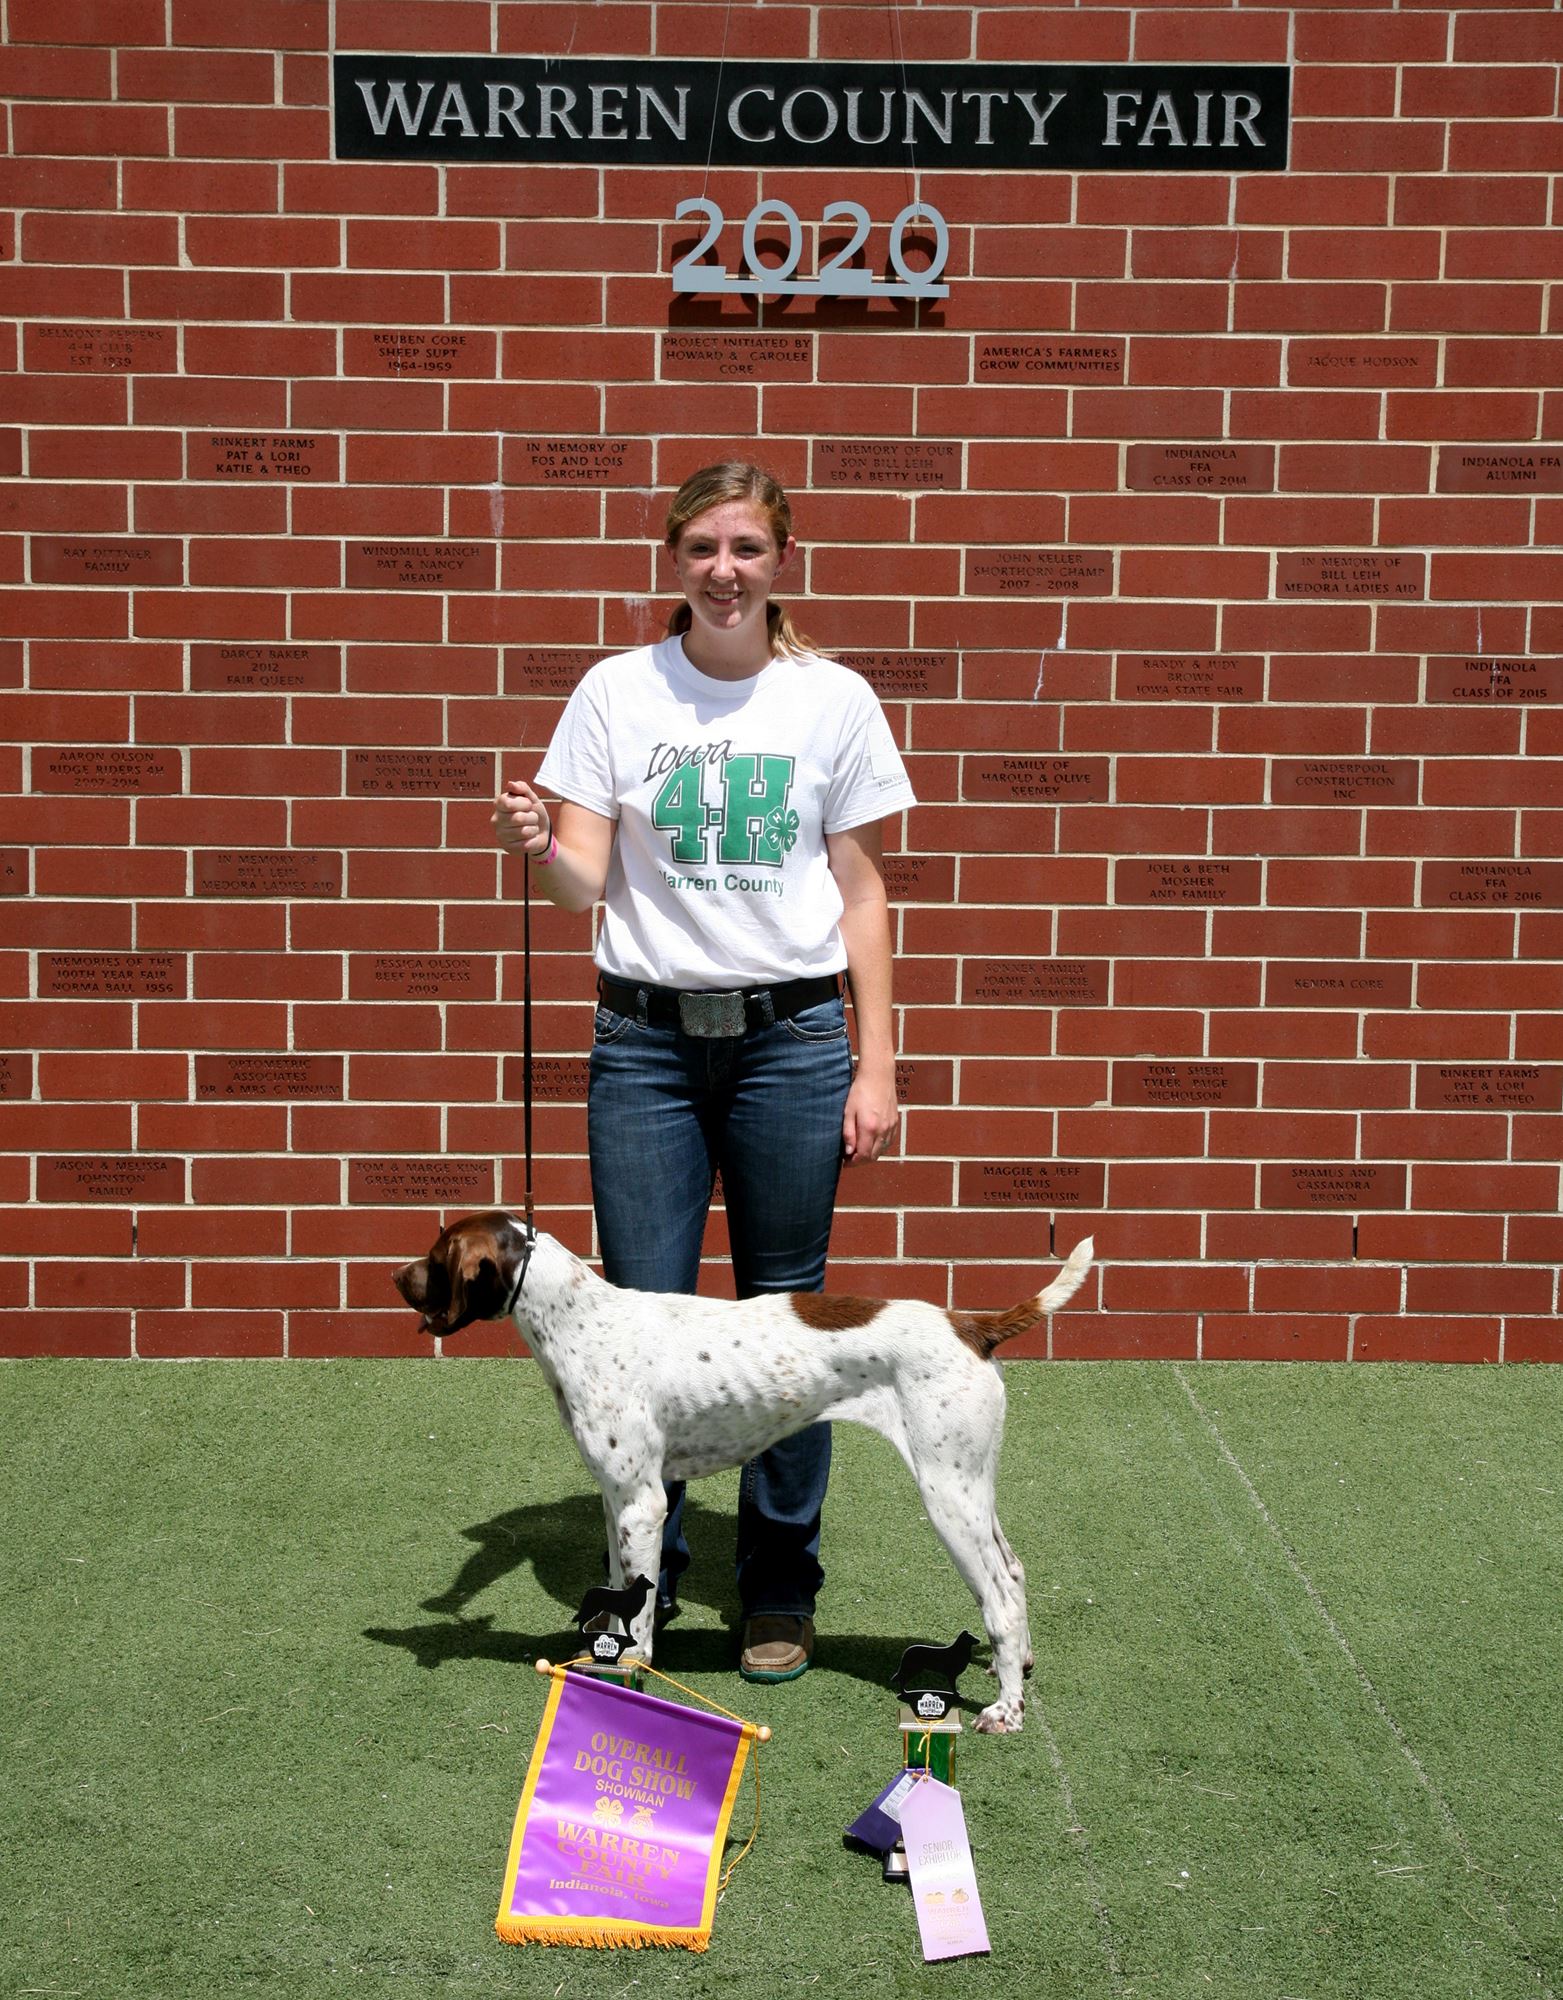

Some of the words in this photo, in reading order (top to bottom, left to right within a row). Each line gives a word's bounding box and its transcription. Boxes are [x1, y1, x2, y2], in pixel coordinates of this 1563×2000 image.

[353, 79, 690, 140] WARREN
[727, 88, 1068, 146] COUNTY
[1102, 93, 1267, 148] FAIR
[673, 197, 949, 288] 2020
[373, 336, 426, 345] REUBEN
[431, 336, 466, 345] CORE
[664, 338, 718, 348] PROJECT
[724, 338, 788, 348] INITIATED
[794, 338, 810, 348] BY
[378, 348, 420, 358] SHEEP
[426, 348, 458, 358] SUPT
[666, 351, 724, 362] HOWARD
[728, 351, 738, 362] &
[749, 351, 809, 362] CAROLEE
[982, 348, 1052, 358] AMERICA'S
[1059, 348, 1117, 358] FARMERS
[388, 362, 452, 371] 1964-1969
[720, 365, 754, 374] CORE
[979, 361, 1021, 371] GROW
[1025, 361, 1120, 371] COMMUNITIES
[211, 438, 267, 449] RINKERT
[273, 438, 315, 449] FARMS
[527, 443, 540, 454] IN
[547, 443, 605, 454] MEMORY
[611, 443, 628, 454] OF
[821, 445, 834, 456] IN
[841, 445, 899, 456] MEMORY
[905, 445, 921, 456] OF
[928, 445, 953, 456] OUR
[1165, 450, 1237, 459] INDIANOLA
[226, 451, 248, 461] PAT
[255, 451, 264, 461] &
[271, 451, 300, 461] LORI
[531, 456, 556, 466] FOS
[561, 456, 588, 466] AND
[594, 456, 623, 466] LOIS
[1462, 457, 1534, 467] INDIANOLA
[1540, 457, 1561, 467] FFA
[216, 464, 253, 475] KATIE
[260, 464, 268, 475] &
[275, 464, 311, 475] THEO
[1190, 463, 1211, 472] FFA
[544, 469, 609, 479] SARCHETT
[830, 472, 847, 482] ED
[854, 472, 863, 482] &
[869, 472, 908, 482] BETTY
[915, 472, 943, 482] LEIH
[1486, 470, 1537, 480] ALUMNI
[1153, 476, 1191, 485] CLASS
[1197, 476, 1214, 485] OF
[1219, 476, 1247, 485] 2014
[362, 547, 430, 557] WINDMILL
[435, 547, 480, 557] RANCH
[996, 554, 1032, 564] JOHN
[1038, 554, 1083, 564] KELLER
[1302, 558, 1316, 568] IN
[1321, 558, 1378, 568] MEMORY
[1384, 558, 1401, 568] OF
[377, 560, 398, 570] PAT
[404, 560, 413, 570] &
[420, 560, 464, 570] NANCY
[974, 567, 1053, 577] SHORTHORN
[1060, 567, 1105, 577] CHAMP
[1321, 570, 1346, 580] BILL
[1352, 570, 1381, 580] LEIH
[398, 573, 444, 583] MEADE
[220, 649, 262, 660] DARCY
[269, 649, 309, 660] BAKER
[251, 663, 279, 673] 2012
[1465, 662, 1536, 673] INDIANOLA
[227, 676, 254, 686] FAIR
[260, 676, 304, 686] QUEEN
[1489, 675, 1511, 686] FFA
[1452, 688, 1490, 698] CLASS
[1495, 688, 1513, 698] OF
[1519, 688, 1547, 698] 2015
[59, 752, 105, 762] AARON
[110, 752, 154, 762] OLSON
[643, 739, 736, 783] Iowa
[49, 765, 89, 775] RIDGE
[95, 765, 141, 775] RIDERS
[146, 765, 164, 775] 4H
[1003, 761, 1047, 771] FAMILY
[1052, 761, 1069, 771] OF
[1303, 764, 1389, 774] VANDERPOOL
[981, 774, 1033, 784] HAROLD
[1039, 774, 1048, 784] &
[1054, 774, 1091, 784] OLIVE
[1295, 776, 1395, 786] CONSTRUCTION
[1011, 786, 1060, 796] KEENEY
[1333, 790, 1356, 799] INC
[1147, 864, 1177, 874] JOEL
[1183, 864, 1192, 874] &
[1198, 864, 1230, 874] BETH
[1460, 866, 1532, 877] INDIANOLA
[724, 874, 784, 897] County
[1160, 877, 1215, 887] MOSHER
[1485, 879, 1507, 888] FFA
[1149, 890, 1176, 900] AND
[1181, 890, 1227, 900] FAMILY
[1449, 892, 1487, 901] CLASS
[1492, 892, 1509, 901] OF
[1514, 892, 1543, 901] 2016
[51, 957, 121, 968] MEMORIES
[125, 957, 142, 968] OF
[148, 957, 173, 968] THE
[52, 983, 100, 993] NORMA
[105, 983, 135, 993] BALL
[145, 983, 174, 993] 1956
[407, 985, 439, 994] 2009
[1147, 1066, 1176, 1077] TOM
[1187, 1066, 1224, 1077] SHERI
[1440, 1069, 1492, 1079] RINKERT
[1498, 1069, 1540, 1079] FARMS
[1454, 1082, 1476, 1091] PAT
[1480, 1082, 1489, 1091] &
[1496, 1082, 1525, 1091] LORI
[1148, 1091, 1222, 1101] NICHOLSON
[53, 1162, 93, 1172] JASON
[100, 1162, 109, 1172] &
[116, 1162, 168, 1172] MELISSA
[983, 1167, 1034, 1177] MAGGIE
[1039, 1167, 1048, 1177] &
[1055, 1167, 1081, 1177] JEFF
[1291, 1169, 1345, 1179] SHAMUS
[1350, 1169, 1377, 1179] AND
[76, 1175, 145, 1184] JOHNSTON
[364, 1175, 404, 1186] GREAT
[410, 1175, 479, 1186] MEMORIES
[1013, 1180, 1051, 1189] LEWIS
[87, 1187, 134, 1197] FAMILY
[1296, 1182, 1371, 1192] CASSANDRA
[983, 1192, 1011, 1202] LEIH
[1017, 1192, 1080, 1202] LIMOUSIN
[1310, 1194, 1357, 1203] BROWN
[920, 1700, 943, 1710] WARREN
[591, 1732, 689, 1775] OVERALL
[573, 1750, 623, 1781] DOG
[629, 1766, 698, 1800] SHOW
[596, 1779, 665, 1808] SHOWMAN
[556, 1820, 681, 1866] WARREN
[922, 1840, 953, 1854] SENIOR
[556, 1841, 674, 1881] COUNTY
[580, 1861, 648, 1890] FAIR
[549, 1878, 629, 1900] Indianola,
[633, 1892, 669, 1909] Iowa
